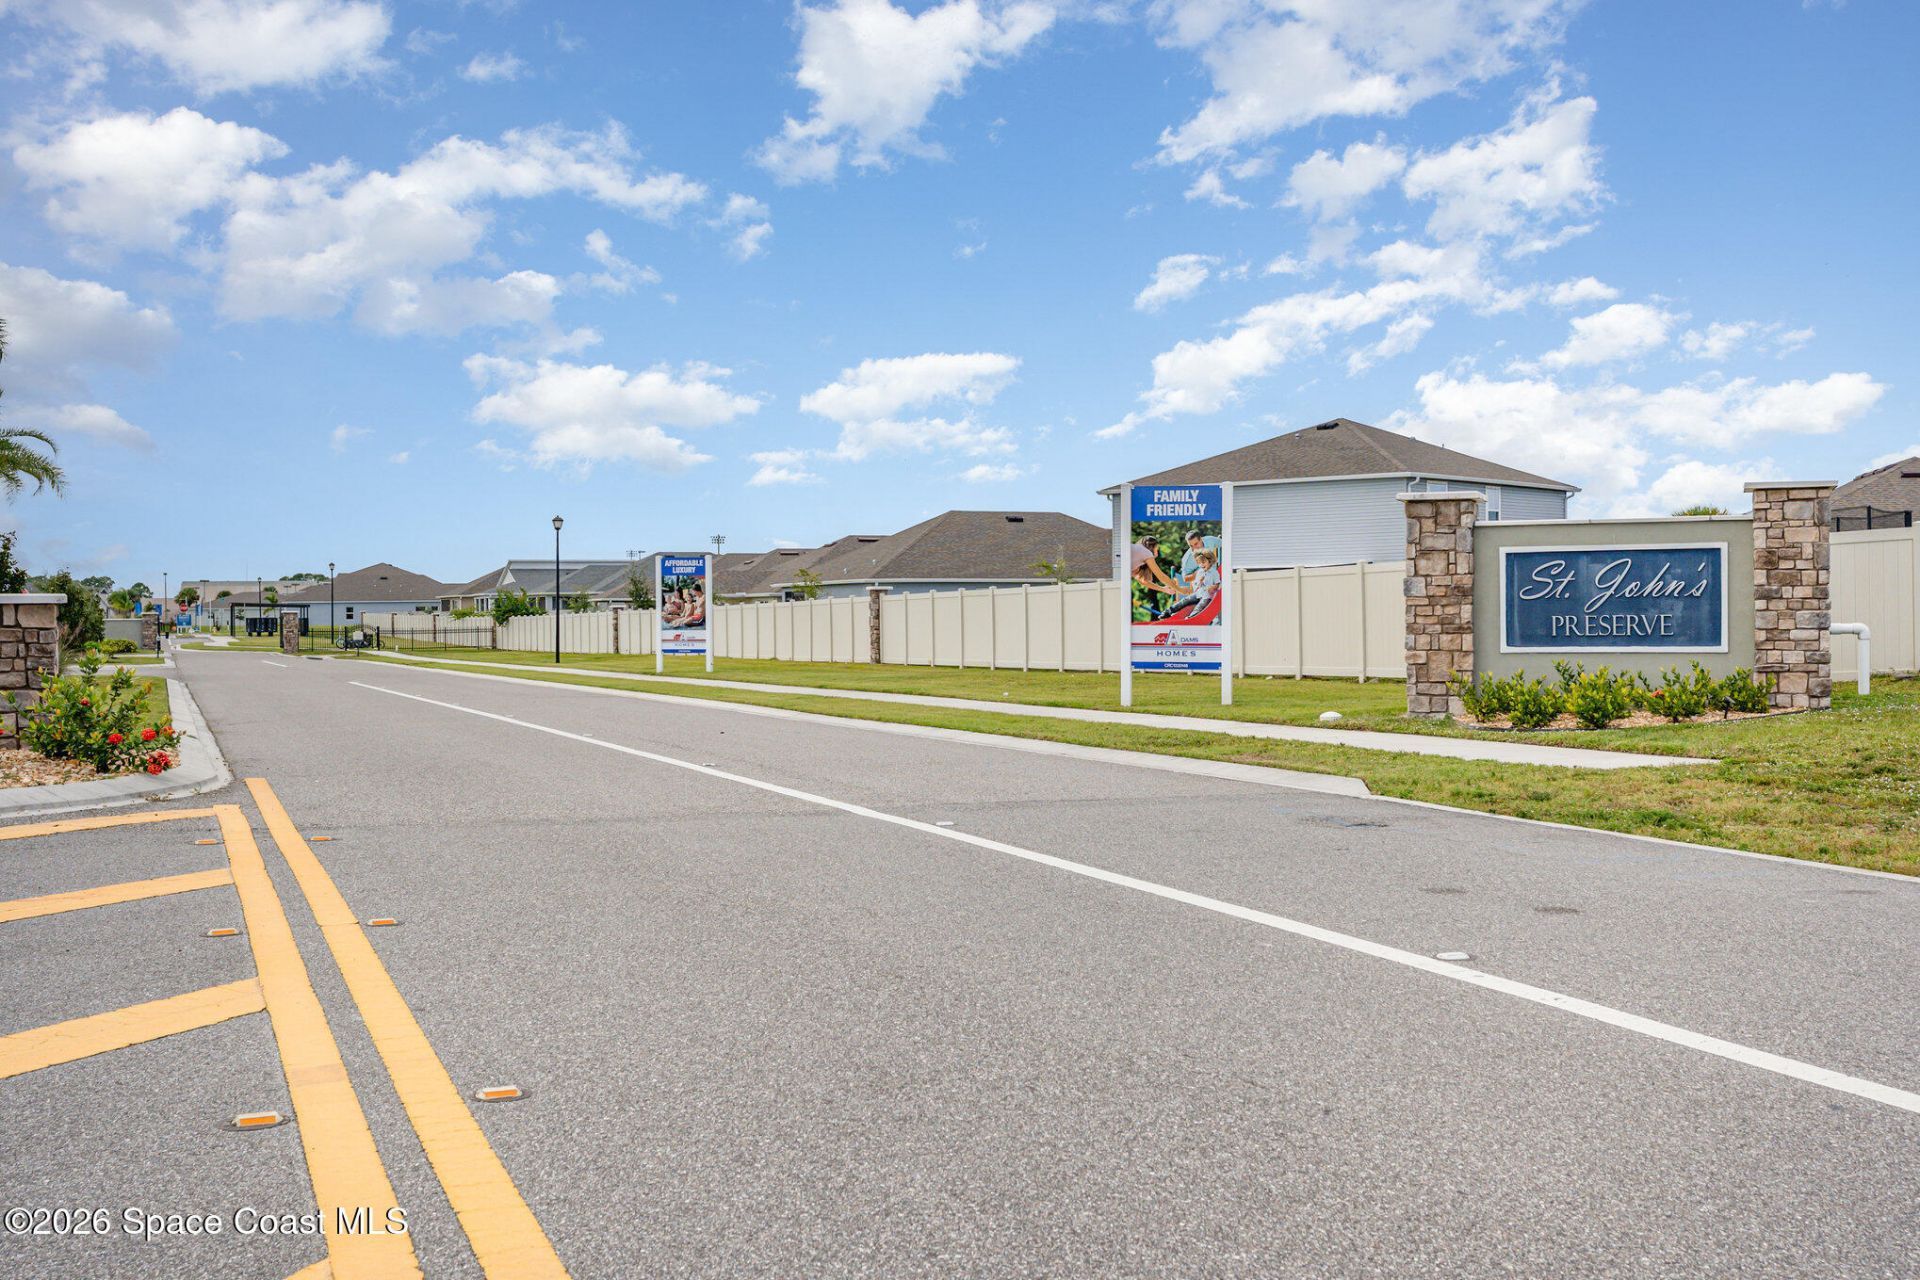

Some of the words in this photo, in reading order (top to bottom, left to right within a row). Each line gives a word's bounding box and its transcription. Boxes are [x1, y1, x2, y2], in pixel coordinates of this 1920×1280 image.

[1153, 489, 1199, 502] FAMILY
[1146, 503, 1206, 516] FRIENDLY
[1519, 560, 1575, 600] St.
[1584, 558, 1708, 613] John's
[1552, 614, 1674, 637] PRESERVE
